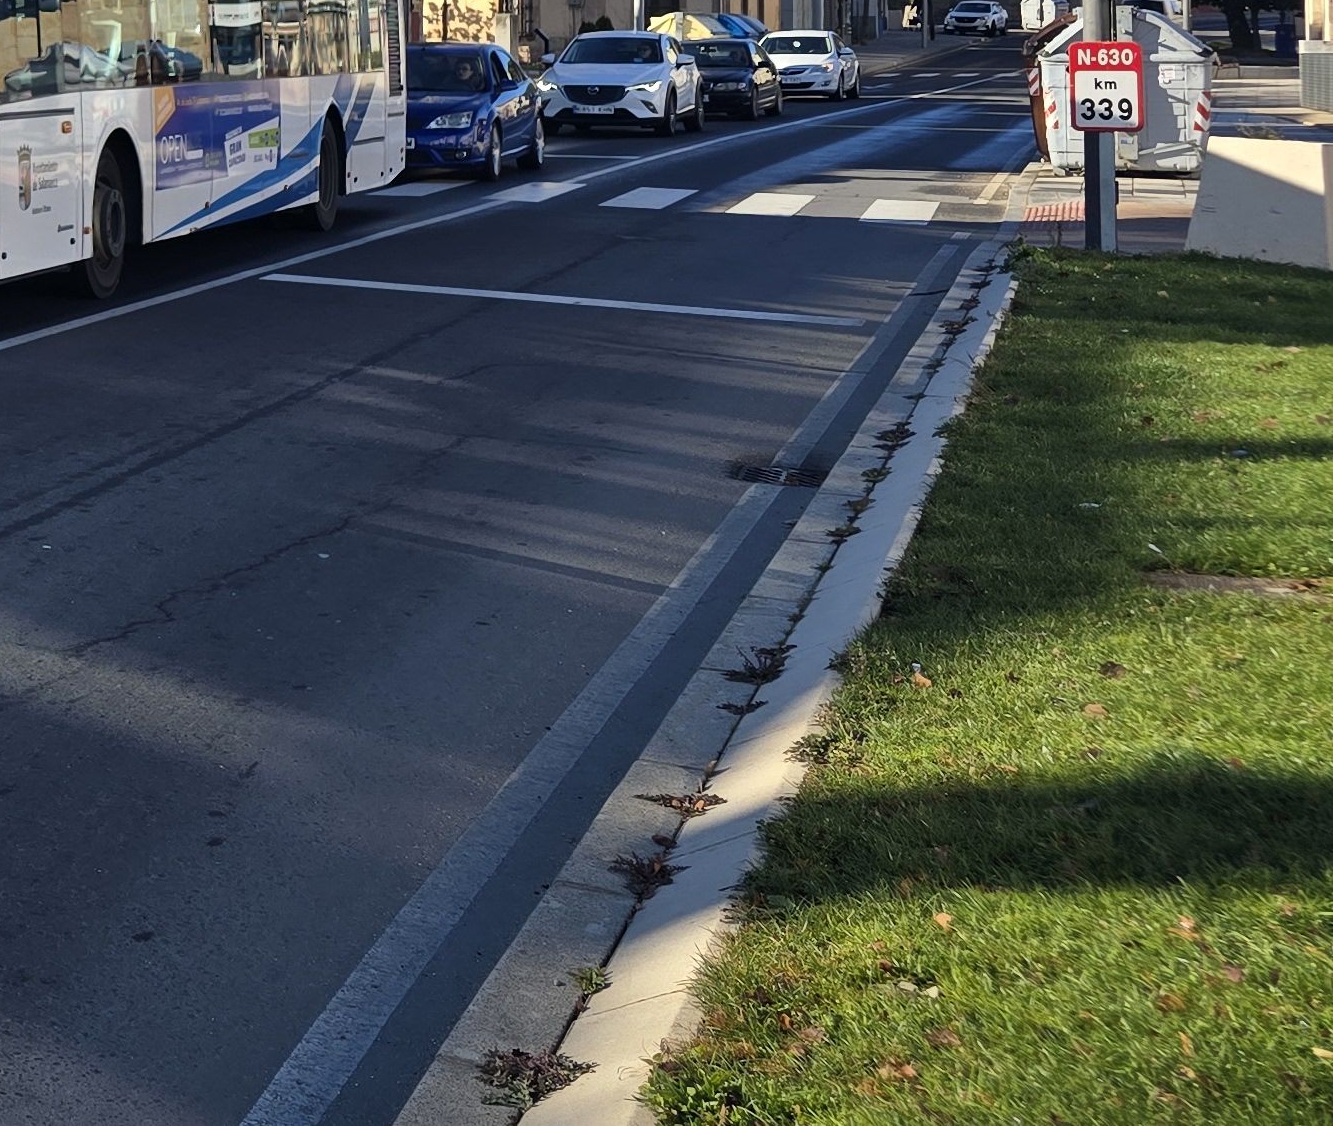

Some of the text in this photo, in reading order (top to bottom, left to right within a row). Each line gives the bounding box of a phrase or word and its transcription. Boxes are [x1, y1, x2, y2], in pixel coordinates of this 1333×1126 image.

[1077, 48, 1134, 66] N-630
[1094, 77, 1117, 90] km
[1080, 97, 1133, 121] 339
[159, 134, 189, 165] OPEN
